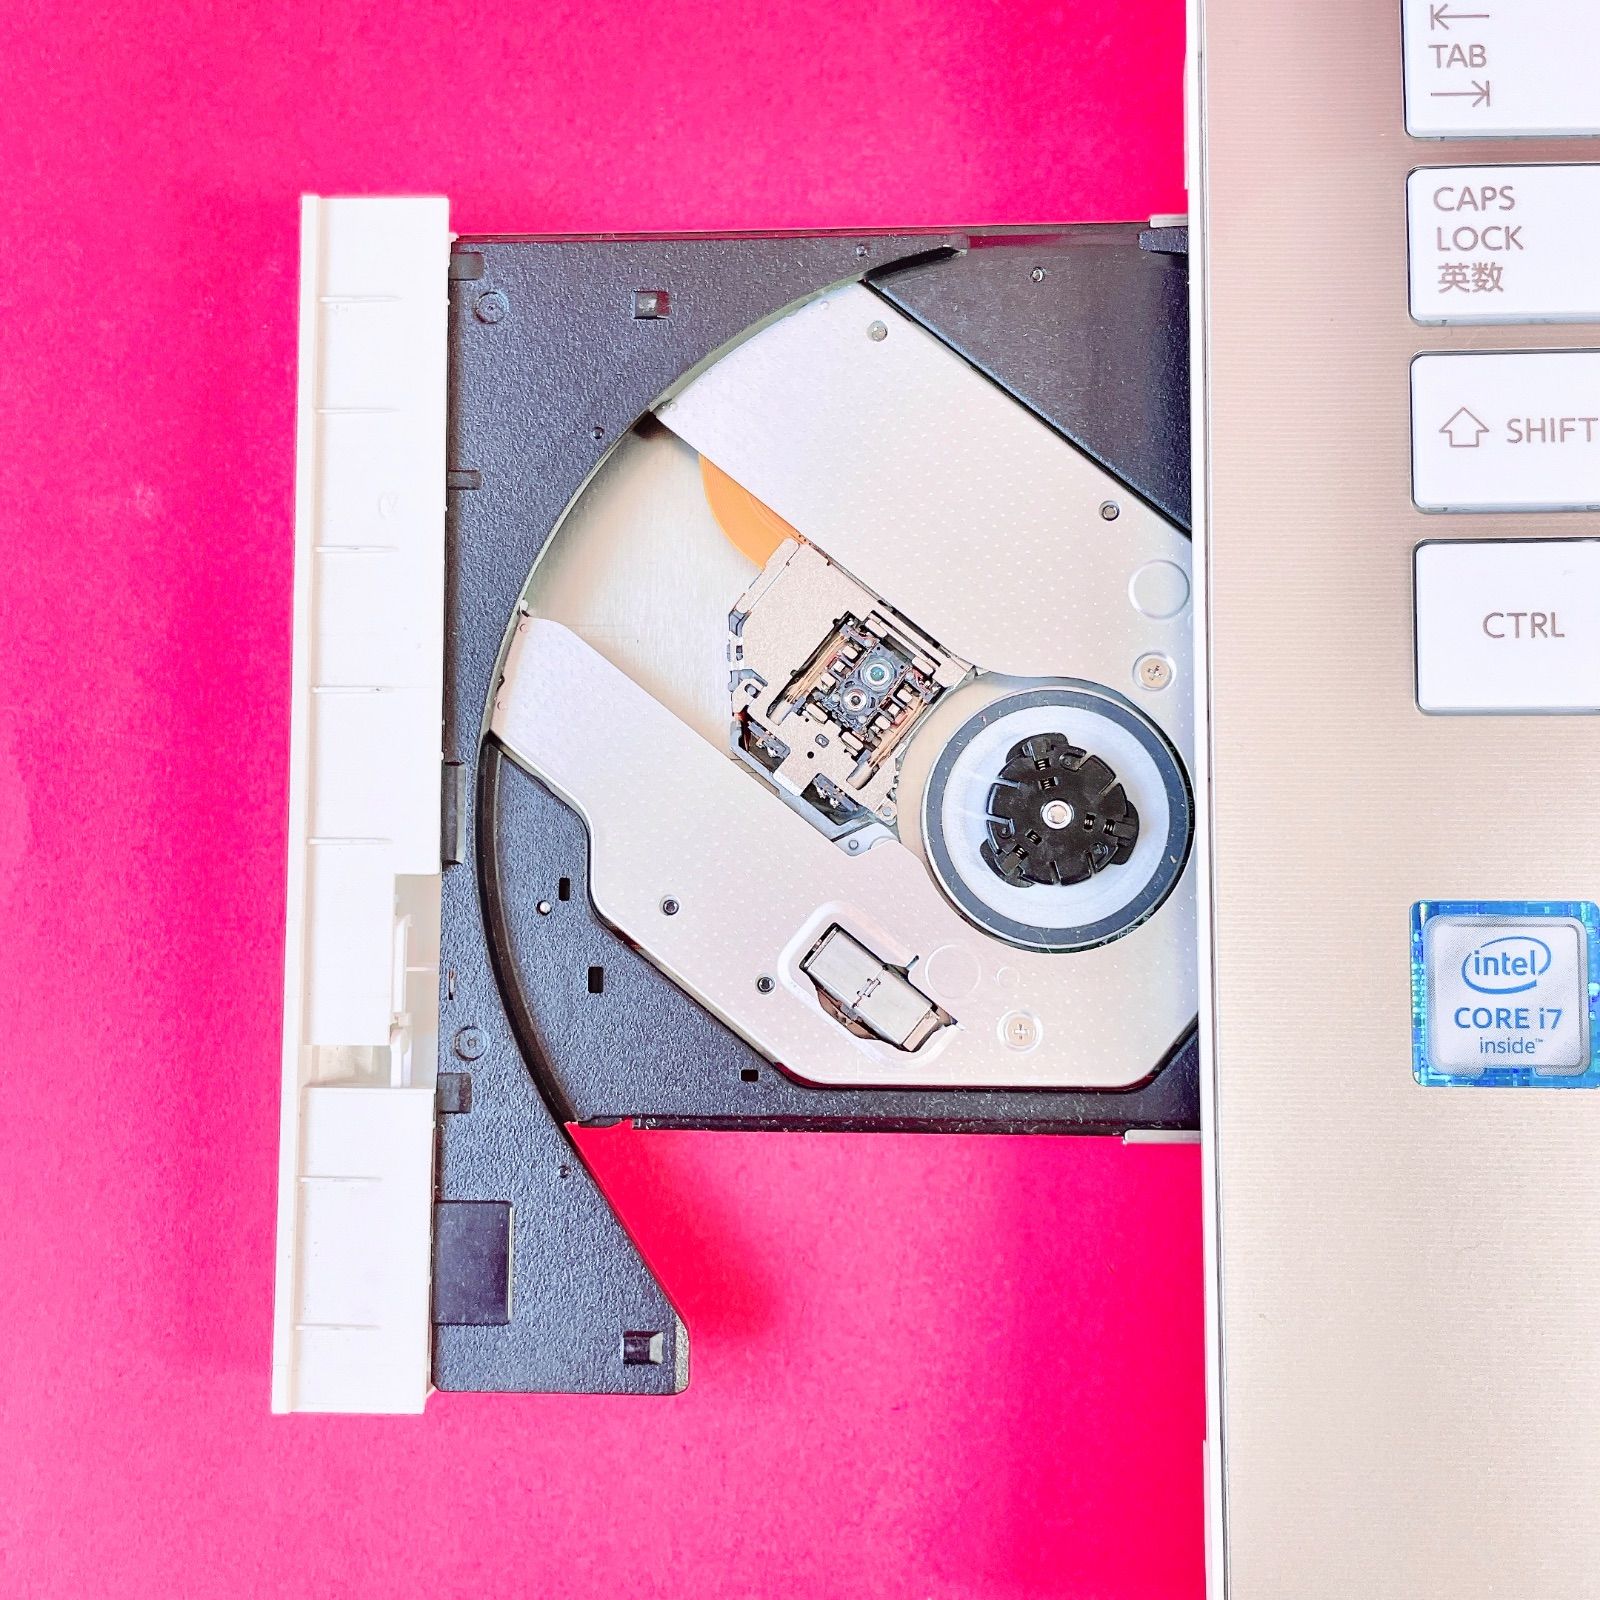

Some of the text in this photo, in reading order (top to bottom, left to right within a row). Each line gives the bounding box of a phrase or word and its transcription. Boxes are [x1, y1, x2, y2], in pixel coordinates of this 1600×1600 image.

[1428, 43, 1488, 68] TAB
[1433, 186, 1516, 211] CAPS
[1437, 226, 1524, 251] LOCK
[1438, 262, 1504, 293] 英数
[1506, 418, 1599, 444] SHIFT
[1482, 612, 1565, 638] CTRL
[1474, 950, 1536, 976] intel
[1455, 1007, 1563, 1030] CORE i7
